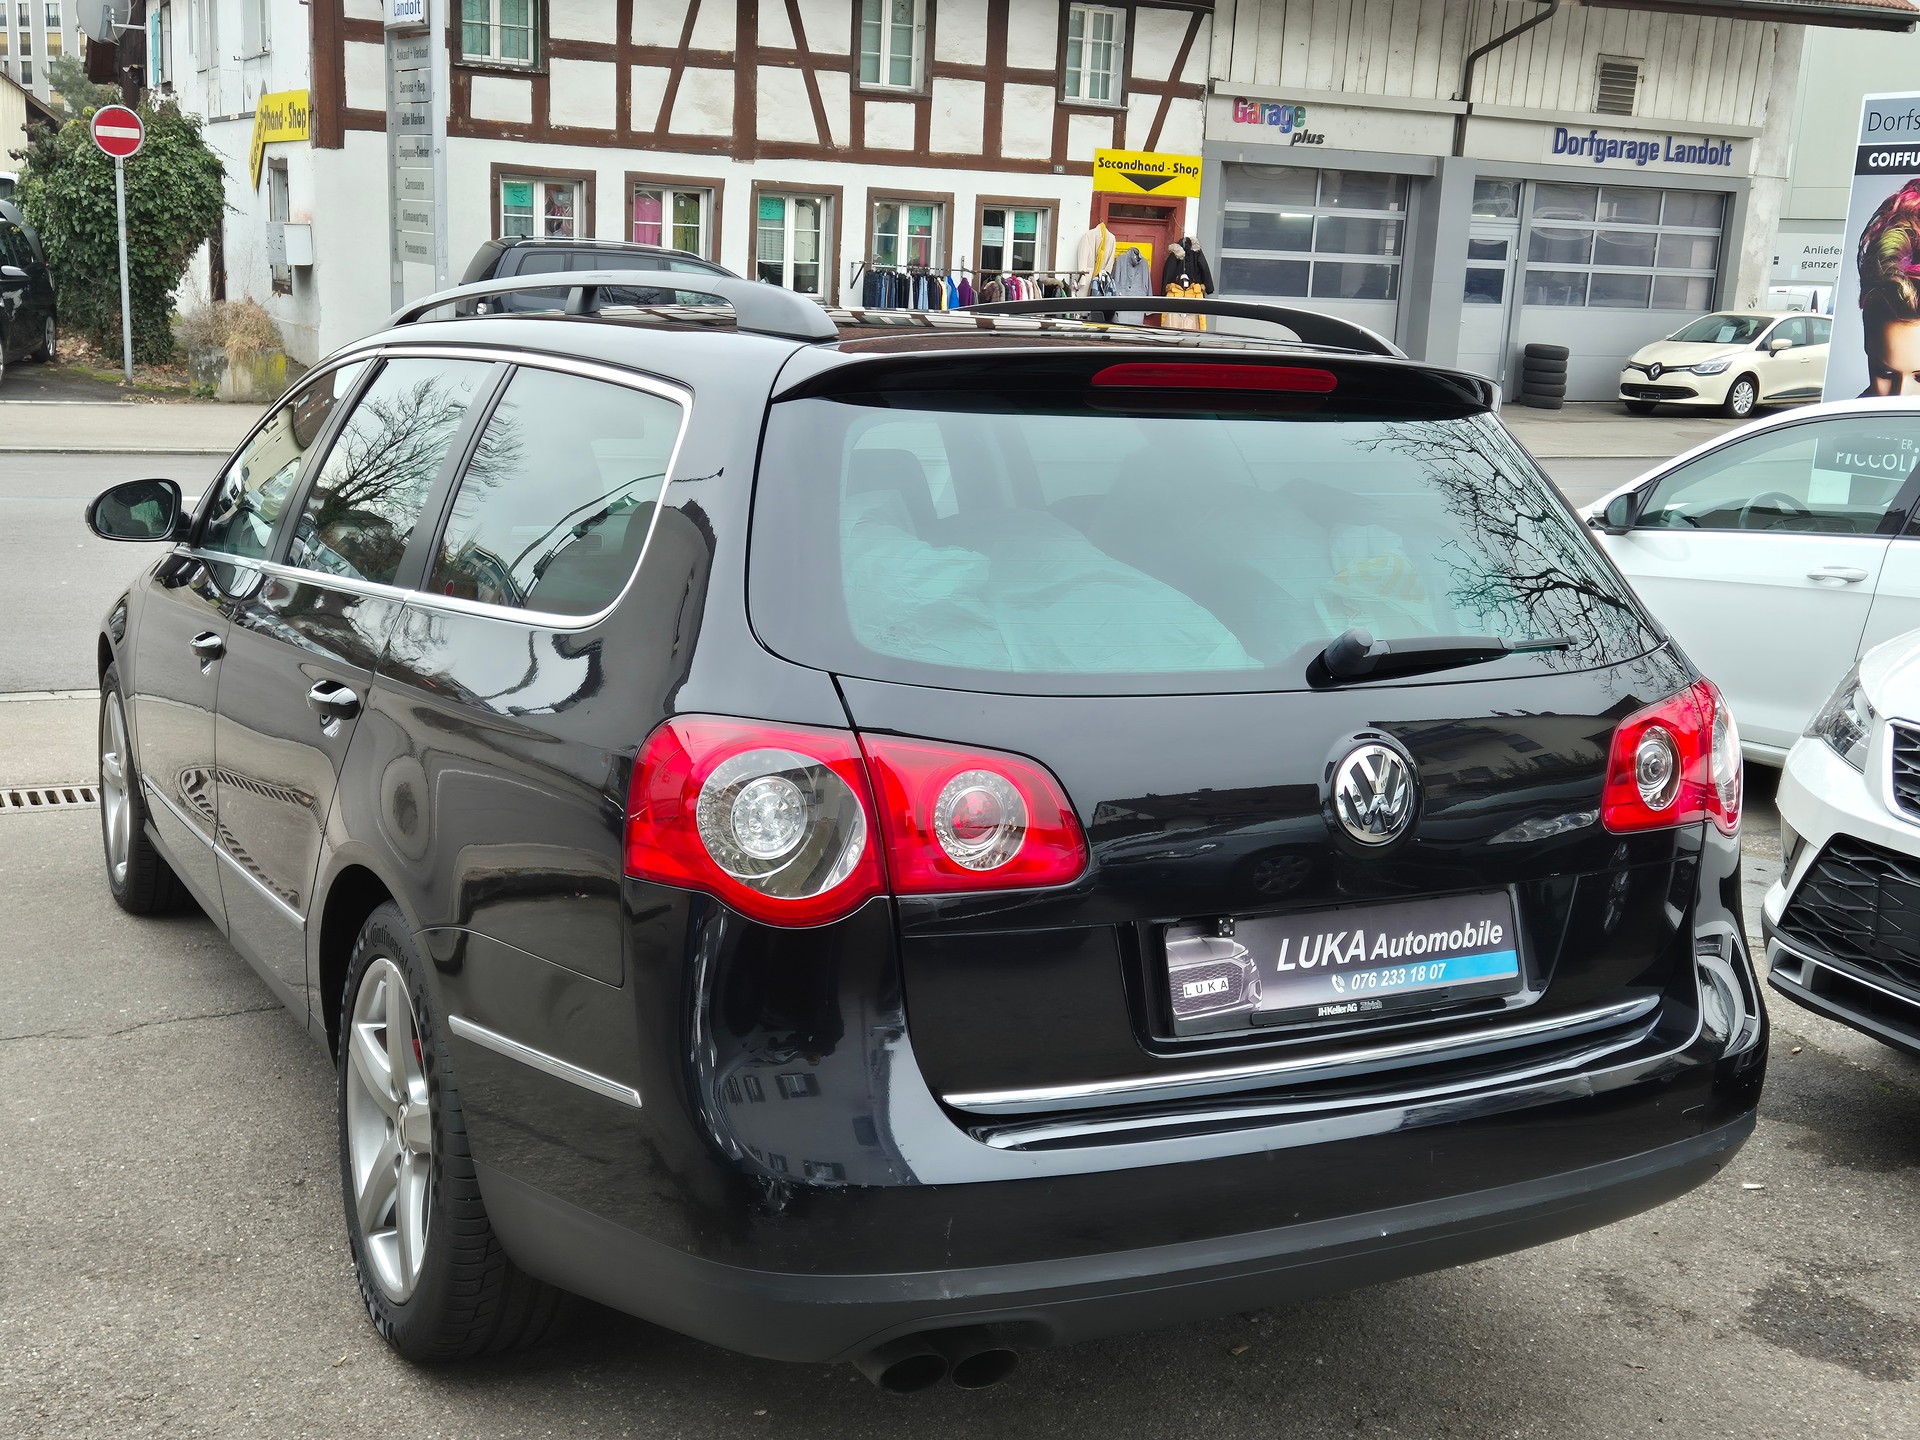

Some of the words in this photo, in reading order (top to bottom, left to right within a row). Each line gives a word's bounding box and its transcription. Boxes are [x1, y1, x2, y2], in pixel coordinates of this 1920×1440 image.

[288, 102, 306, 135] Shop
[1233, 96, 1306, 134] Garage
[1290, 129, 1325, 146] plus
[1552, 127, 1660, 166] Dorfgarage
[1664, 136, 1733, 166] Landolt
[1098, 157, 1165, 172] Secondhand
[1173, 163, 1199, 177] Shop
[1868, 152, 1920, 168] COIFFU
[1801, 260, 1838, 269] ganzer
[1277, 929, 1366, 972] LUKA
[1370, 920, 1503, 960] Automobile
[1184, 980, 1228, 996] LUKA
[1351, 972, 1377, 990] 076
[1381, 968, 1406, 987] 233
[1410, 966, 1426, 982] 18
[1429, 963, 1446, 980] 07
